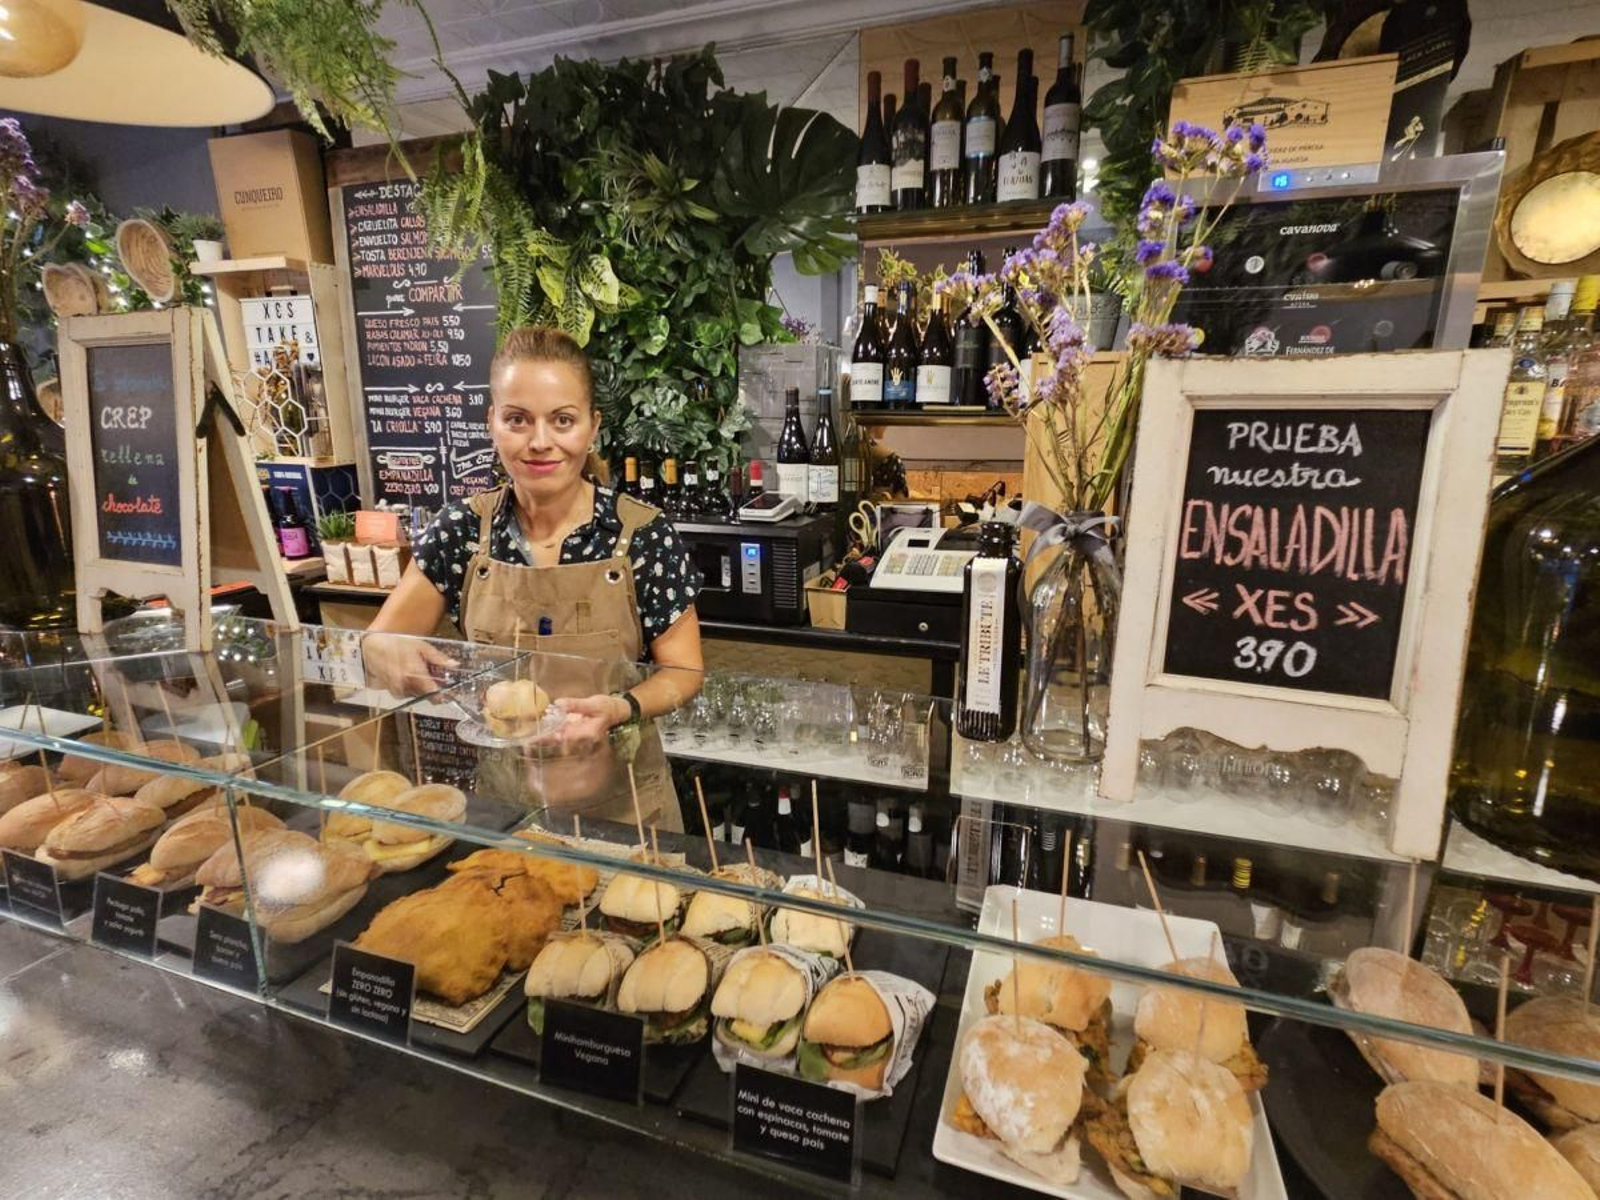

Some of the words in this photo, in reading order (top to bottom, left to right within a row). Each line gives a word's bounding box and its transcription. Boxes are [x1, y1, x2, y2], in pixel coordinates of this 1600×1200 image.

[234, 187, 284, 205] CUNQUEIRO
[358, 232, 398, 247] ENVUELTO
[359, 250, 386, 261] TOSTA
[361, 263, 406, 277] MARVELOUS
[408, 284, 464, 303] COMPARTIR
[389, 318, 420, 329] FRESCO
[255, 324, 298, 344] TAKE
[304, 331, 314, 344] &
[100, 406, 153, 430] CREP
[1227, 421, 1363, 457] PRUEBA
[127, 474, 139, 486] de
[379, 468, 435, 482] EMPANADILLA
[1206, 461, 1362, 490] nuestra
[101, 493, 163, 515] chocolate
[1179, 498, 1409, 586] ENSALADILLA
[1231, 583, 1319, 632] XES
[978, 600, 994, 665] TRIBUTE
[351, 979, 372, 993] ZERO
[372, 985, 394, 999] ZERO
[401, 1008, 407, 1017] y
[553, 1031, 632, 1058] Minihamburguesa
[574, 1049, 609, 1066] Vegana
[738, 1090, 760, 1104] Mini
[761, 1097, 776, 1109] de
[779, 1102, 804, 1117] vaca
[805, 1110, 851, 1129] cachena
[737, 1104, 755, 1117] con
[757, 1110, 810, 1134] espinacas,
[812, 1124, 850, 1144] tomate
[759, 1124, 768, 1136] y
[769, 1127, 800, 1144] queso
